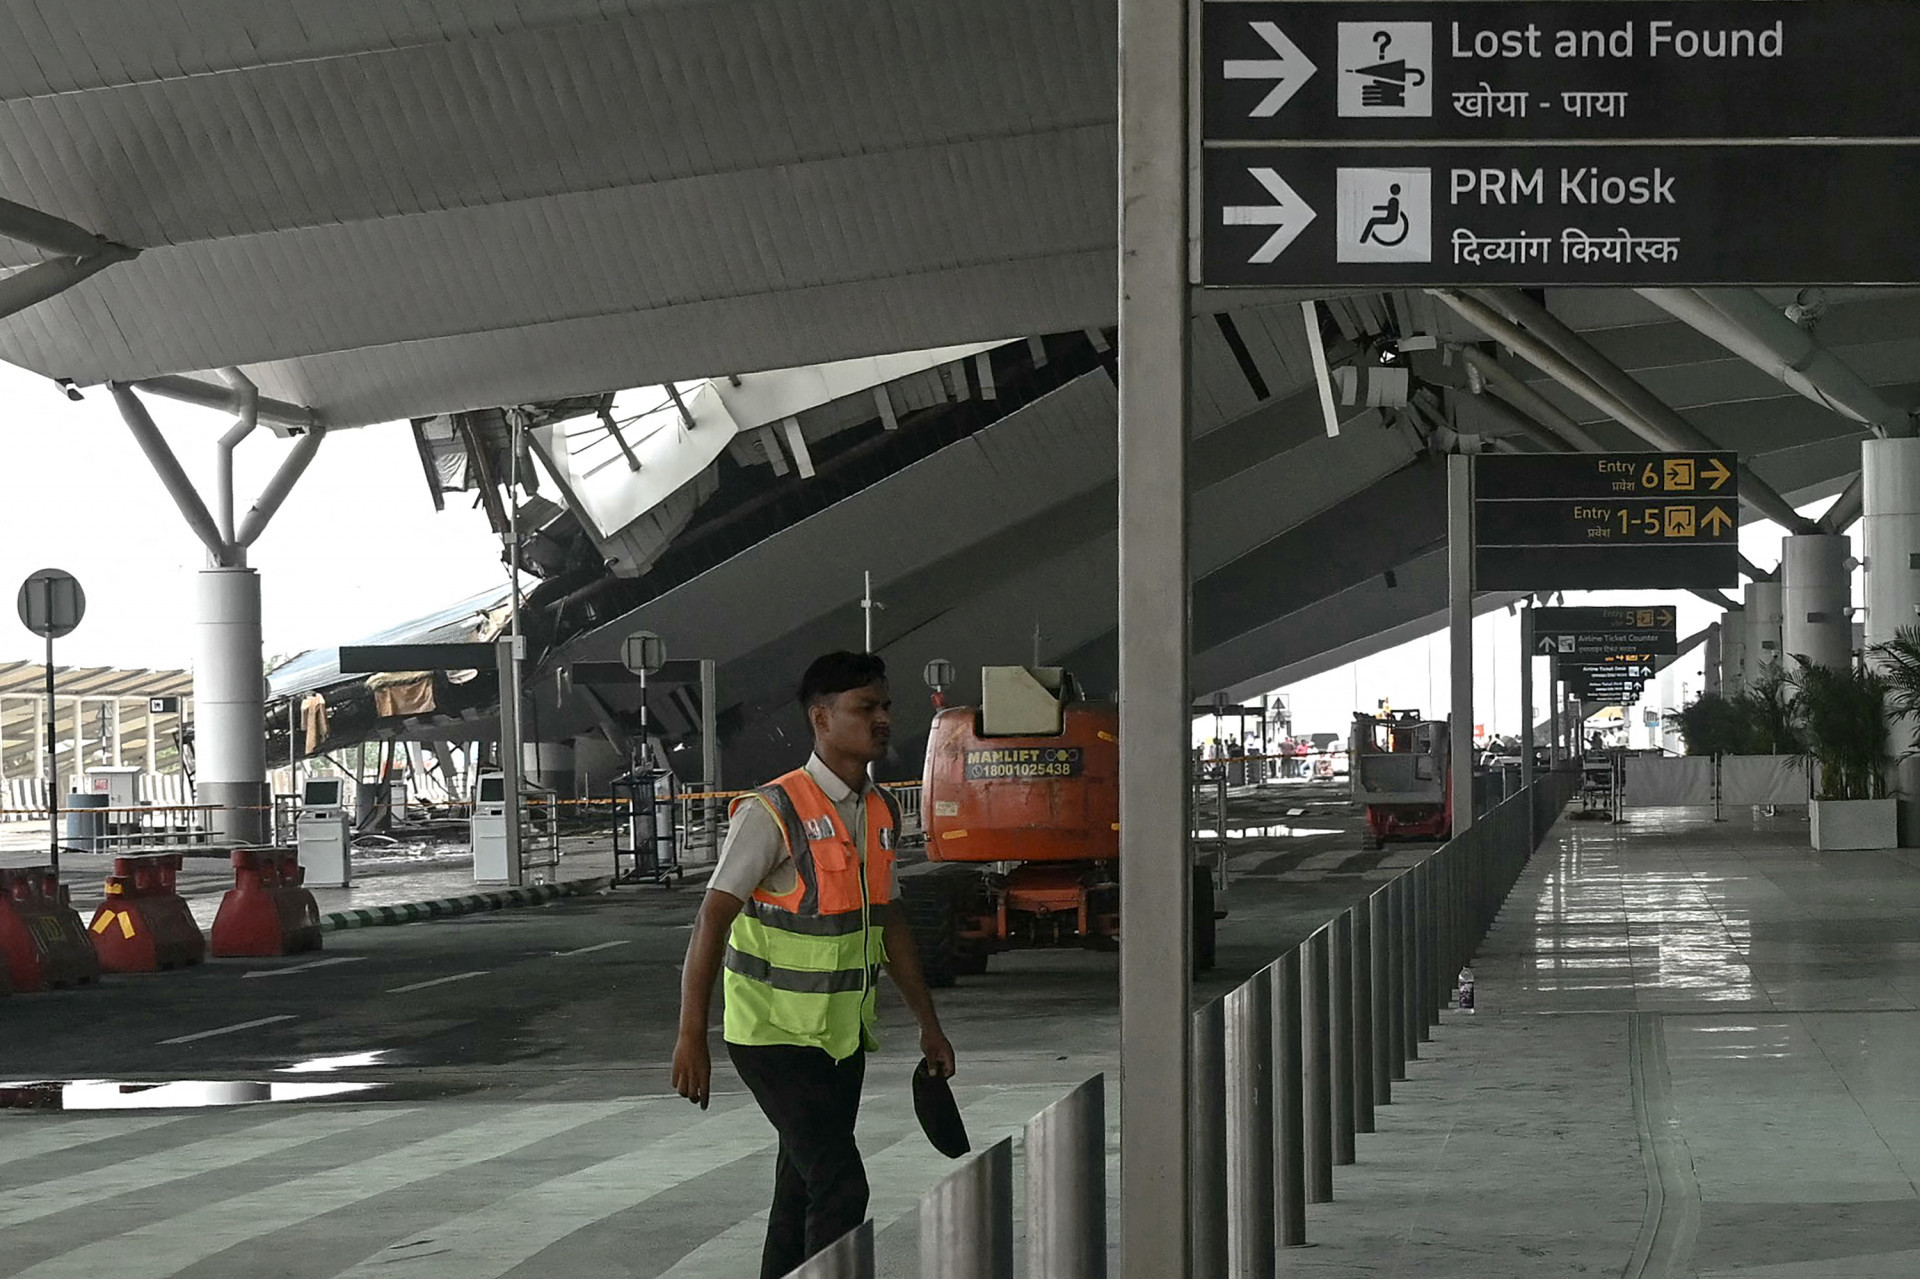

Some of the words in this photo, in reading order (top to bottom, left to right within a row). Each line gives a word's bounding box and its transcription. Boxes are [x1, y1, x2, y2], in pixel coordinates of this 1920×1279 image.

[1451, 20, 1542, 58] Lost
[1554, 20, 1633, 58] and
[1649, 20, 1783, 58] Found
[1451, 82, 1530, 119] खोया
[1560, 91, 1629, 118] पाया
[1450, 168, 1544, 205] PRM
[1560, 167, 1676, 204] Kiosk
[1450, 228, 1552, 266] दिव्यांग
[1560, 227, 1681, 266] कियोस्क
[1598, 459, 1636, 475] Entry
[1641, 462, 1659, 489] 6
[1574, 506, 1611, 522] Entry
[1617, 508, 1660, 535] 1-5
[1625, 610, 1635, 626] 5
[1578, 634, 1603, 643] Airline
[1604, 634, 1627, 642] Ticket
[1628, 634, 1659, 642] Counter
[967, 750, 1040, 764] MANLIFT
[983, 763, 1071, 777] 18001025438
